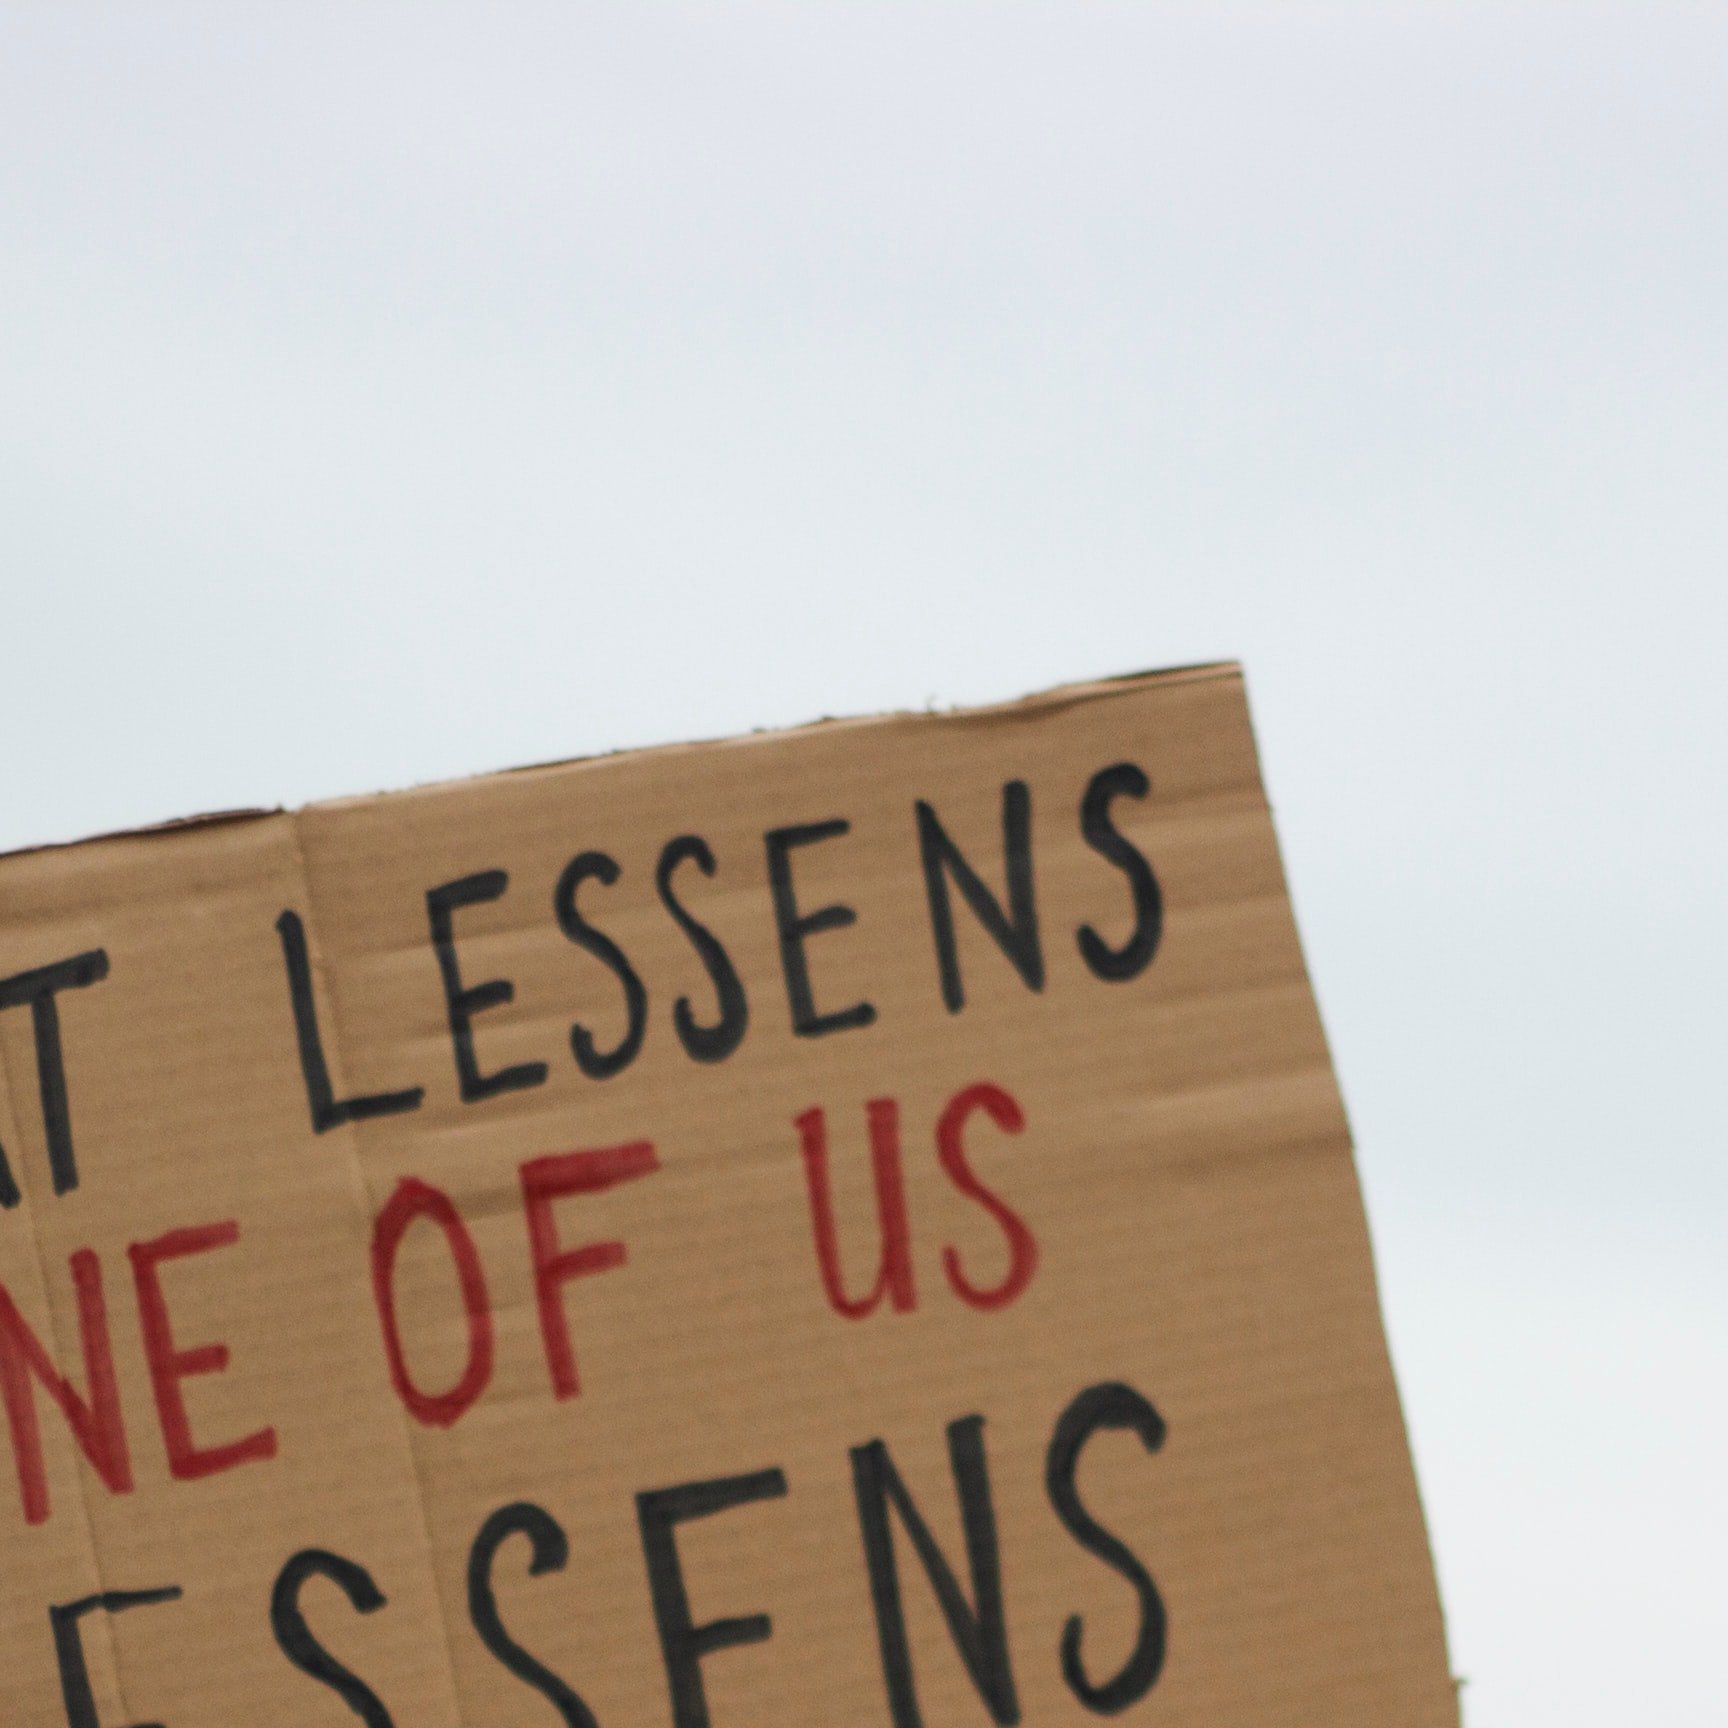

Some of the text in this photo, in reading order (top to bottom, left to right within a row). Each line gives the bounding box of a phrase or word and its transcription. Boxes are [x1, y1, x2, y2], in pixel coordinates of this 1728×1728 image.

[277, 761, 1166, 1136] LESSENS
[369, 1140, 660, 1429] OF
[795, 1080, 1040, 1322] US
